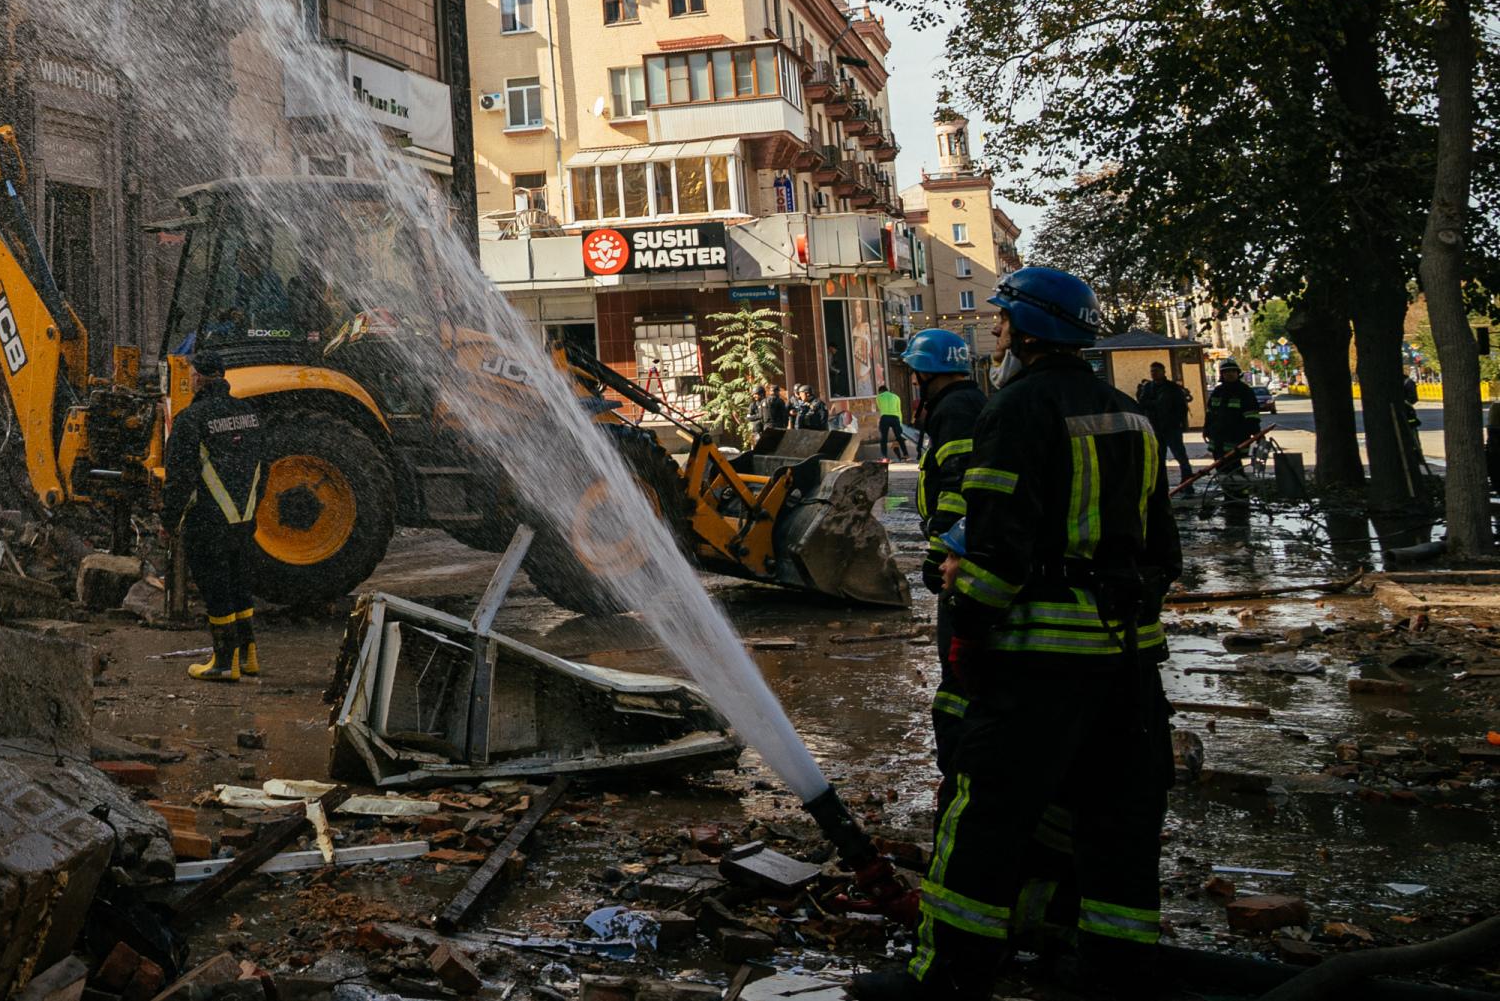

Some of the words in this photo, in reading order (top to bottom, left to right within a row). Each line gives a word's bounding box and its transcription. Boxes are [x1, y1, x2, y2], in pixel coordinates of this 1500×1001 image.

[39, 59, 118, 98] WINETIME
[633, 229, 699, 249] SUSHI
[634, 247, 726, 269] MASTER
[483, 355, 529, 384] JC
